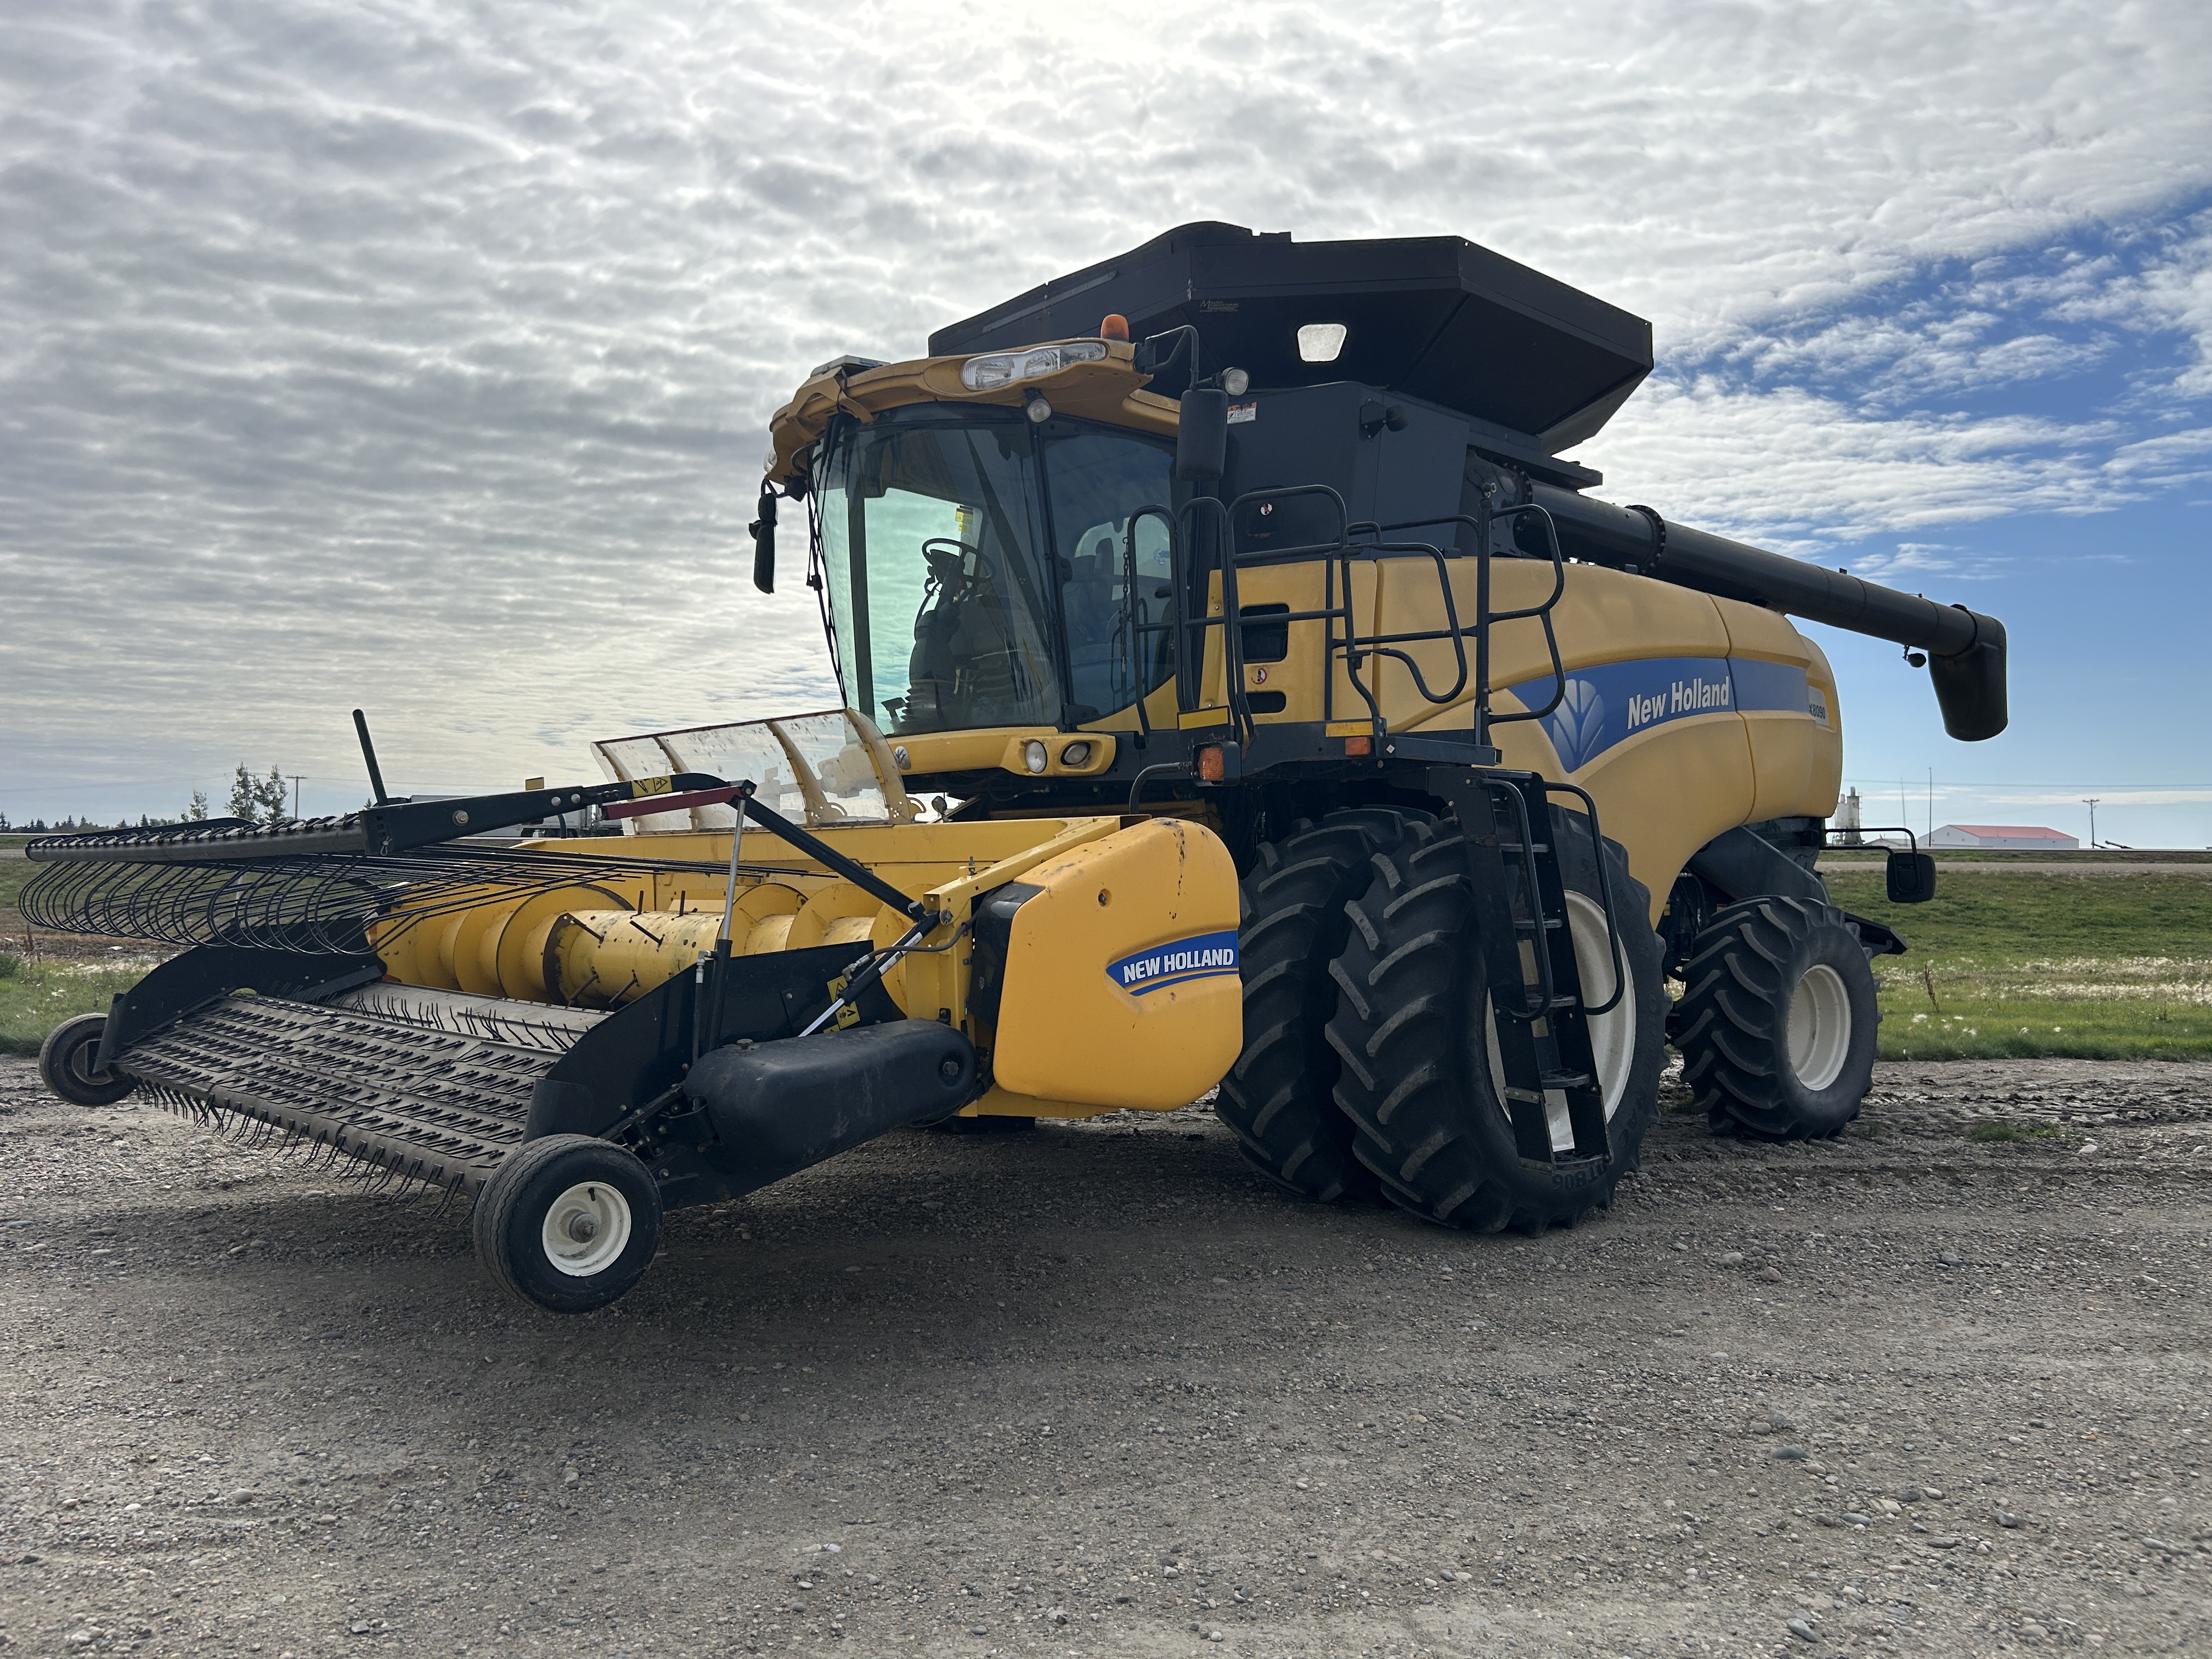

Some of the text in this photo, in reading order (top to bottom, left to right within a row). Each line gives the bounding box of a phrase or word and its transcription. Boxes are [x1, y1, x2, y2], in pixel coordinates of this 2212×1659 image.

[1628, 676, 1729, 730] New Holland
[1809, 703, 1826, 719] X8090
[1124, 949, 1234, 984] NEW HOLLAND
